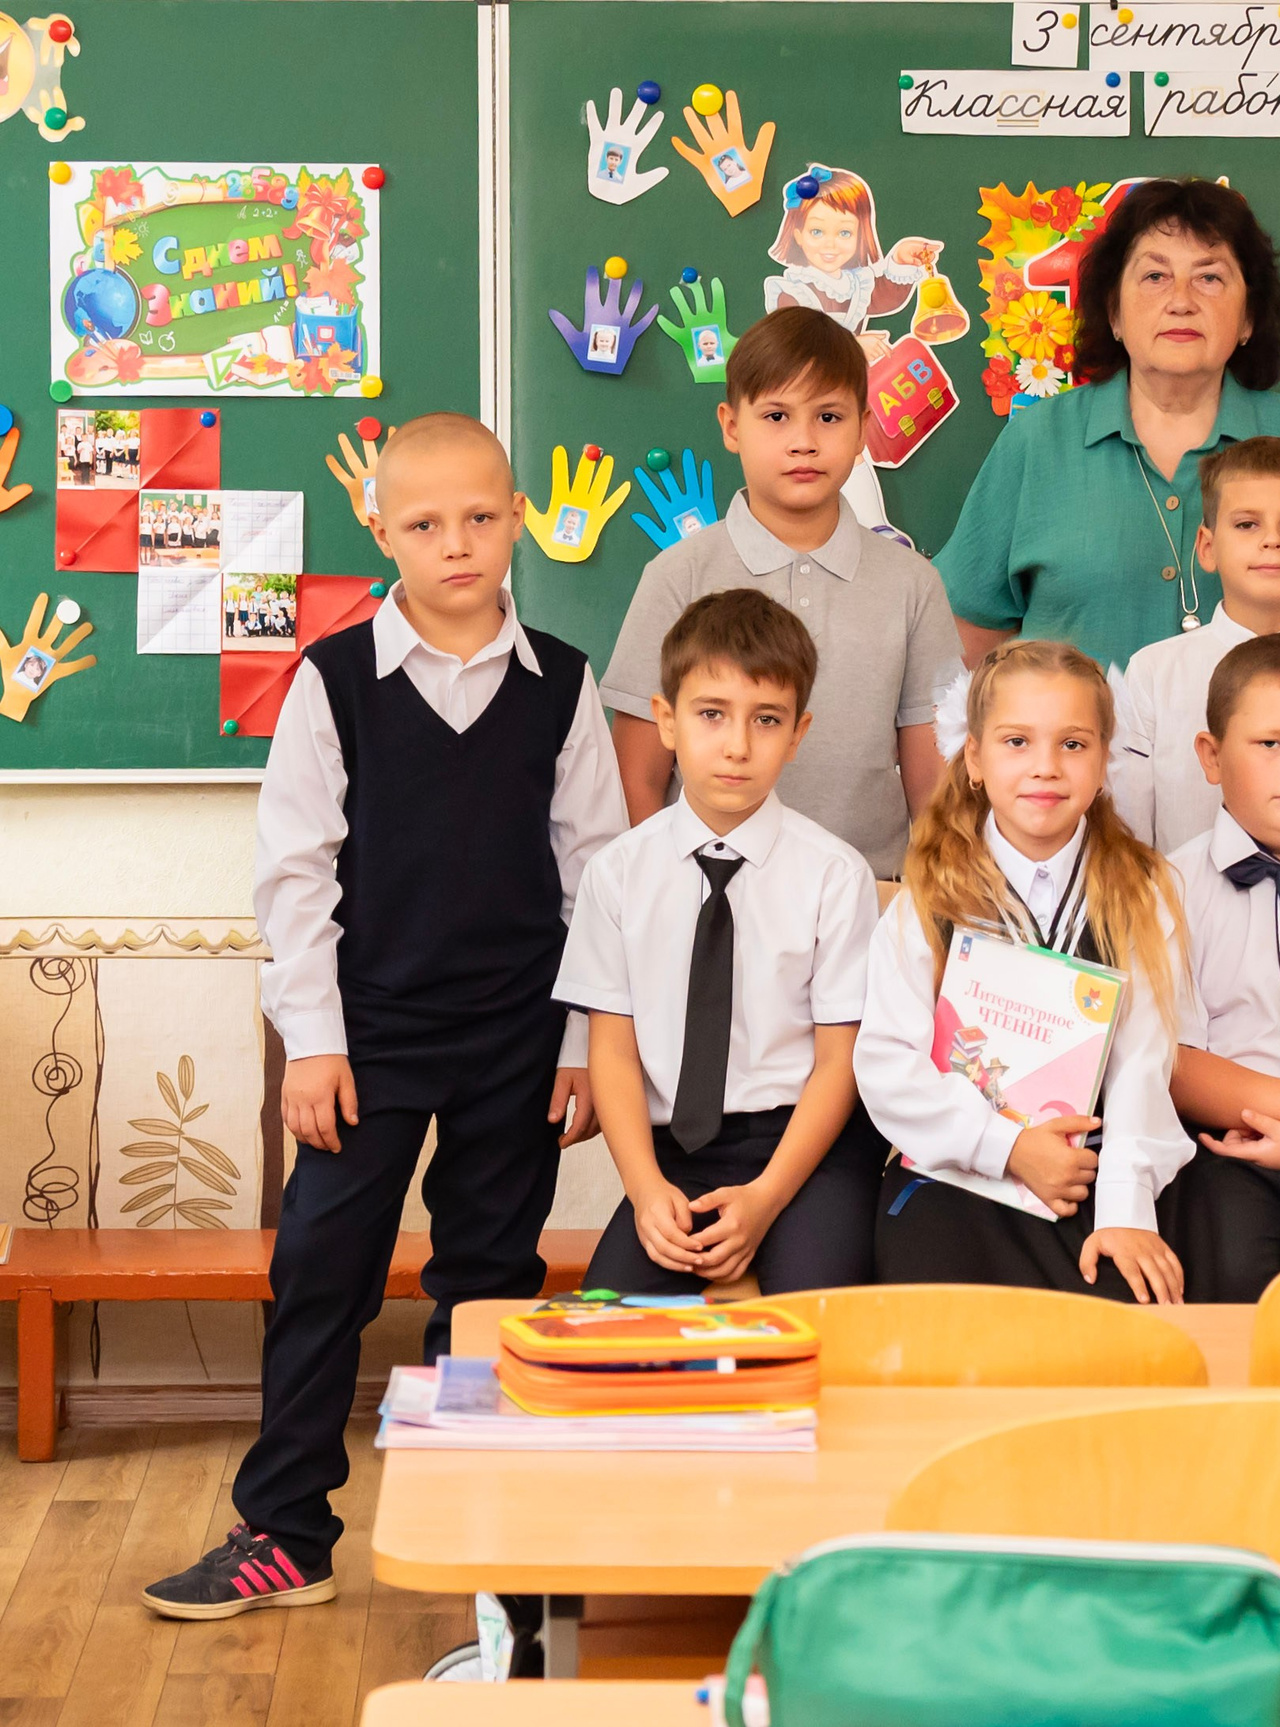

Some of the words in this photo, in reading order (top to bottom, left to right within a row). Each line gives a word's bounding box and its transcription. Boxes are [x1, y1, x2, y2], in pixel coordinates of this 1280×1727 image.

[904, 78, 1128, 119] Классная
[152, 236, 181, 275] С
[182, 234, 283, 280] днем
[140, 263, 299, 327] Знаний!
[878, 358, 933, 417] АБВ
[964, 979, 1075, 1031] Литературное
[978, 1006, 1054, 1045] ЧТЕНИЕ
